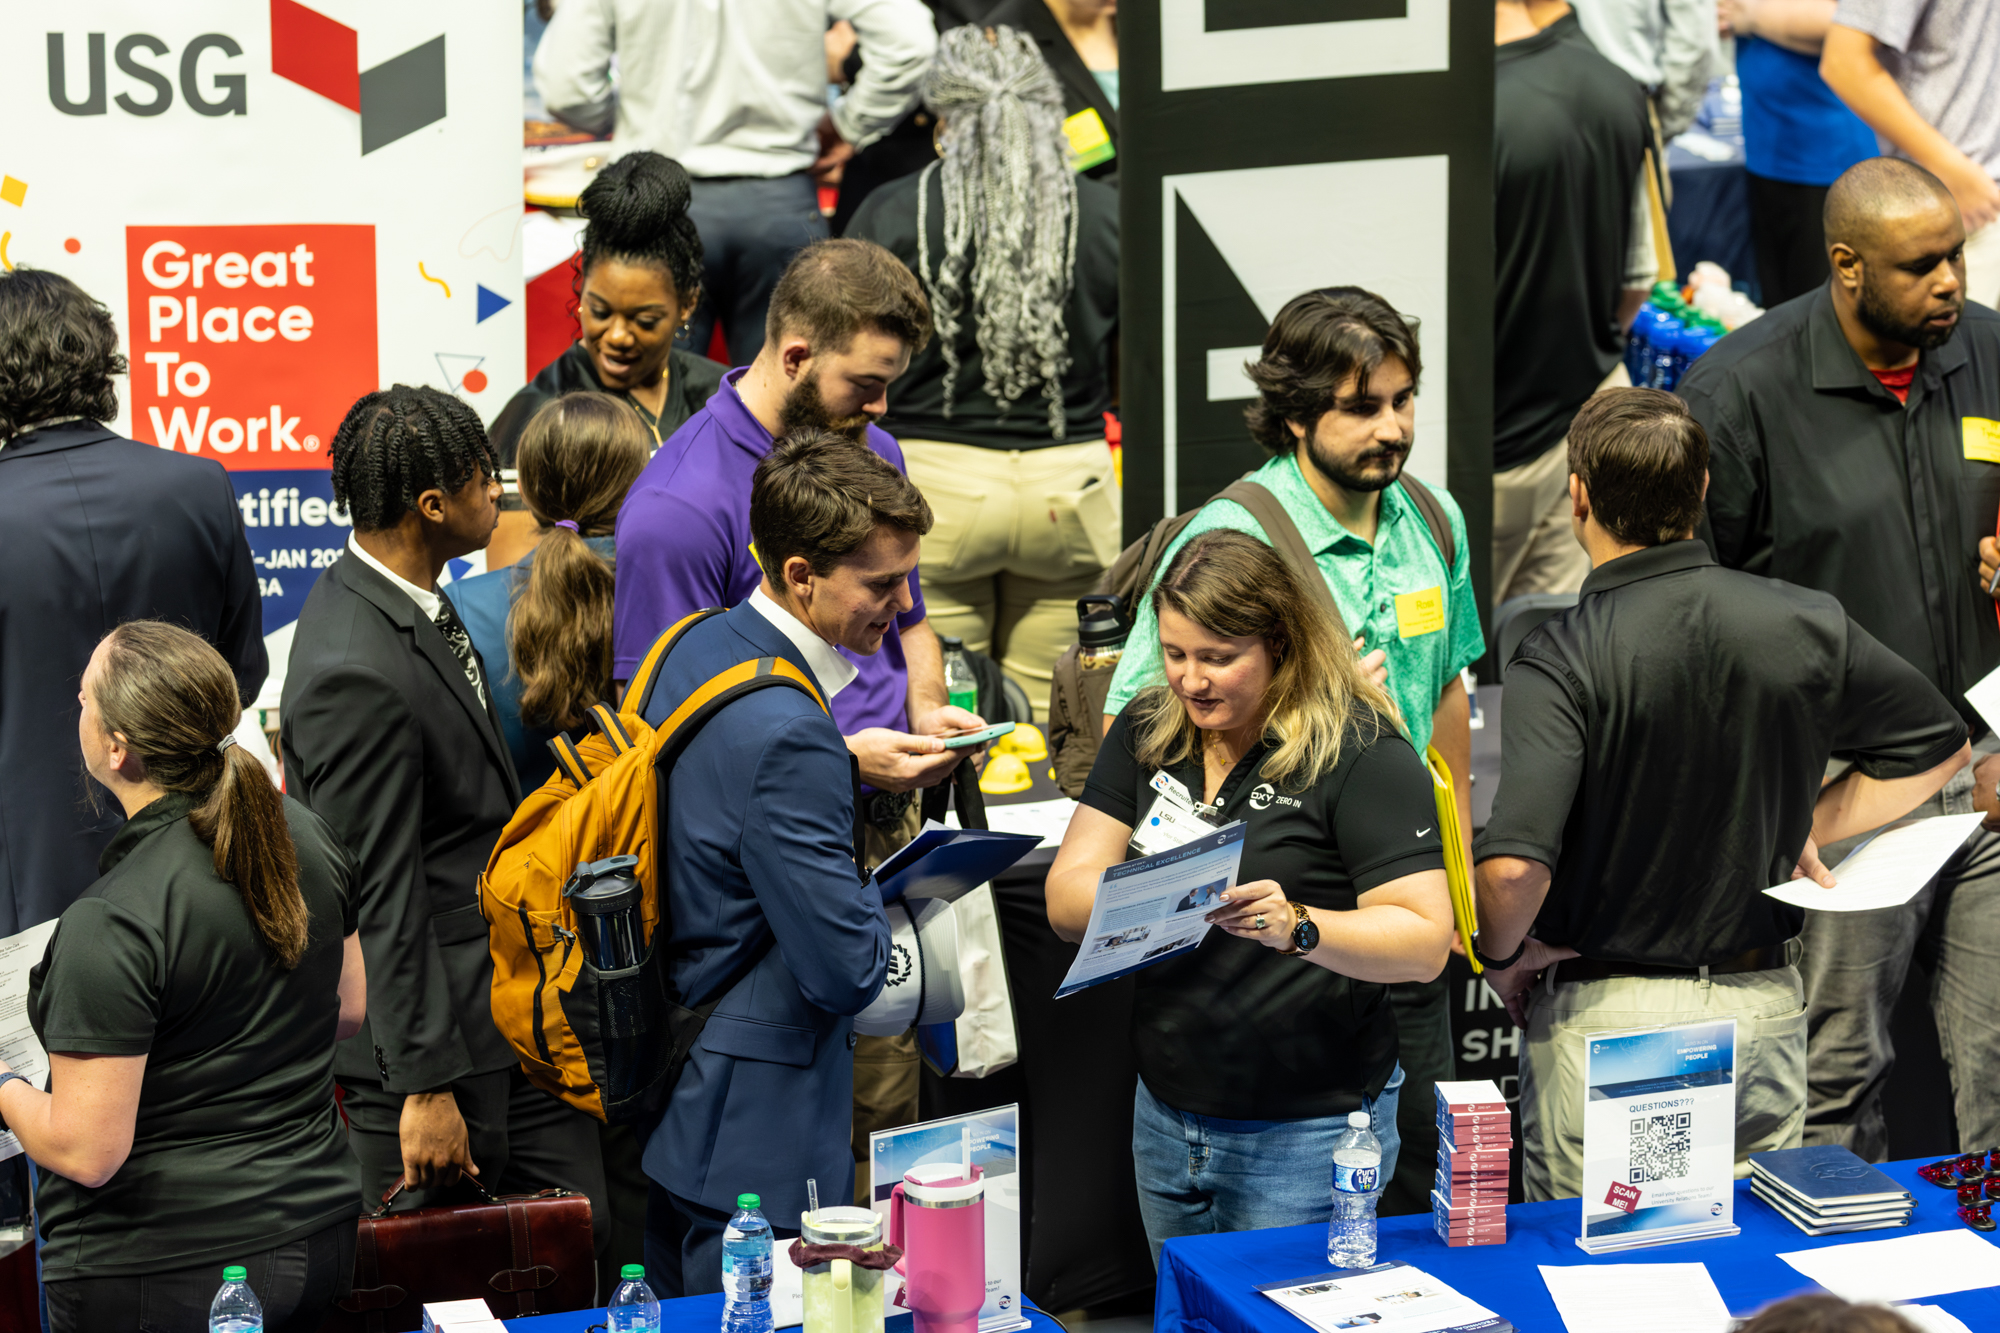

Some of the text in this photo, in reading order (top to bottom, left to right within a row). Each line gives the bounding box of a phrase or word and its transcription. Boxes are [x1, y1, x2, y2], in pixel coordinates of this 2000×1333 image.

[46, 32, 247, 117] USG
[142, 240, 314, 289] Great
[148, 295, 314, 343] Place
[144, 352, 211, 398] To
[258, 577, 284, 597] SA
[1251, 791, 1302, 808] OXY ZERO IN
[1159, 810, 1176, 824] LSU
[1112, 847, 1202, 878] TECHNICAL EXCELLENCE
[1676, 1044, 1717, 1055] EMPOWERING
[1685, 1053, 1709, 1061] PEOPLE
[1629, 1097, 1695, 1113] QUESTIONS???
[960, 1134, 1000, 1147] POWERING
[1356, 1169, 1375, 1177] Pure
[1358, 1176, 1373, 1185] Life
[1612, 1185, 1637, 1200] SCAN
[1611, 1198, 1629, 1210] ME!
